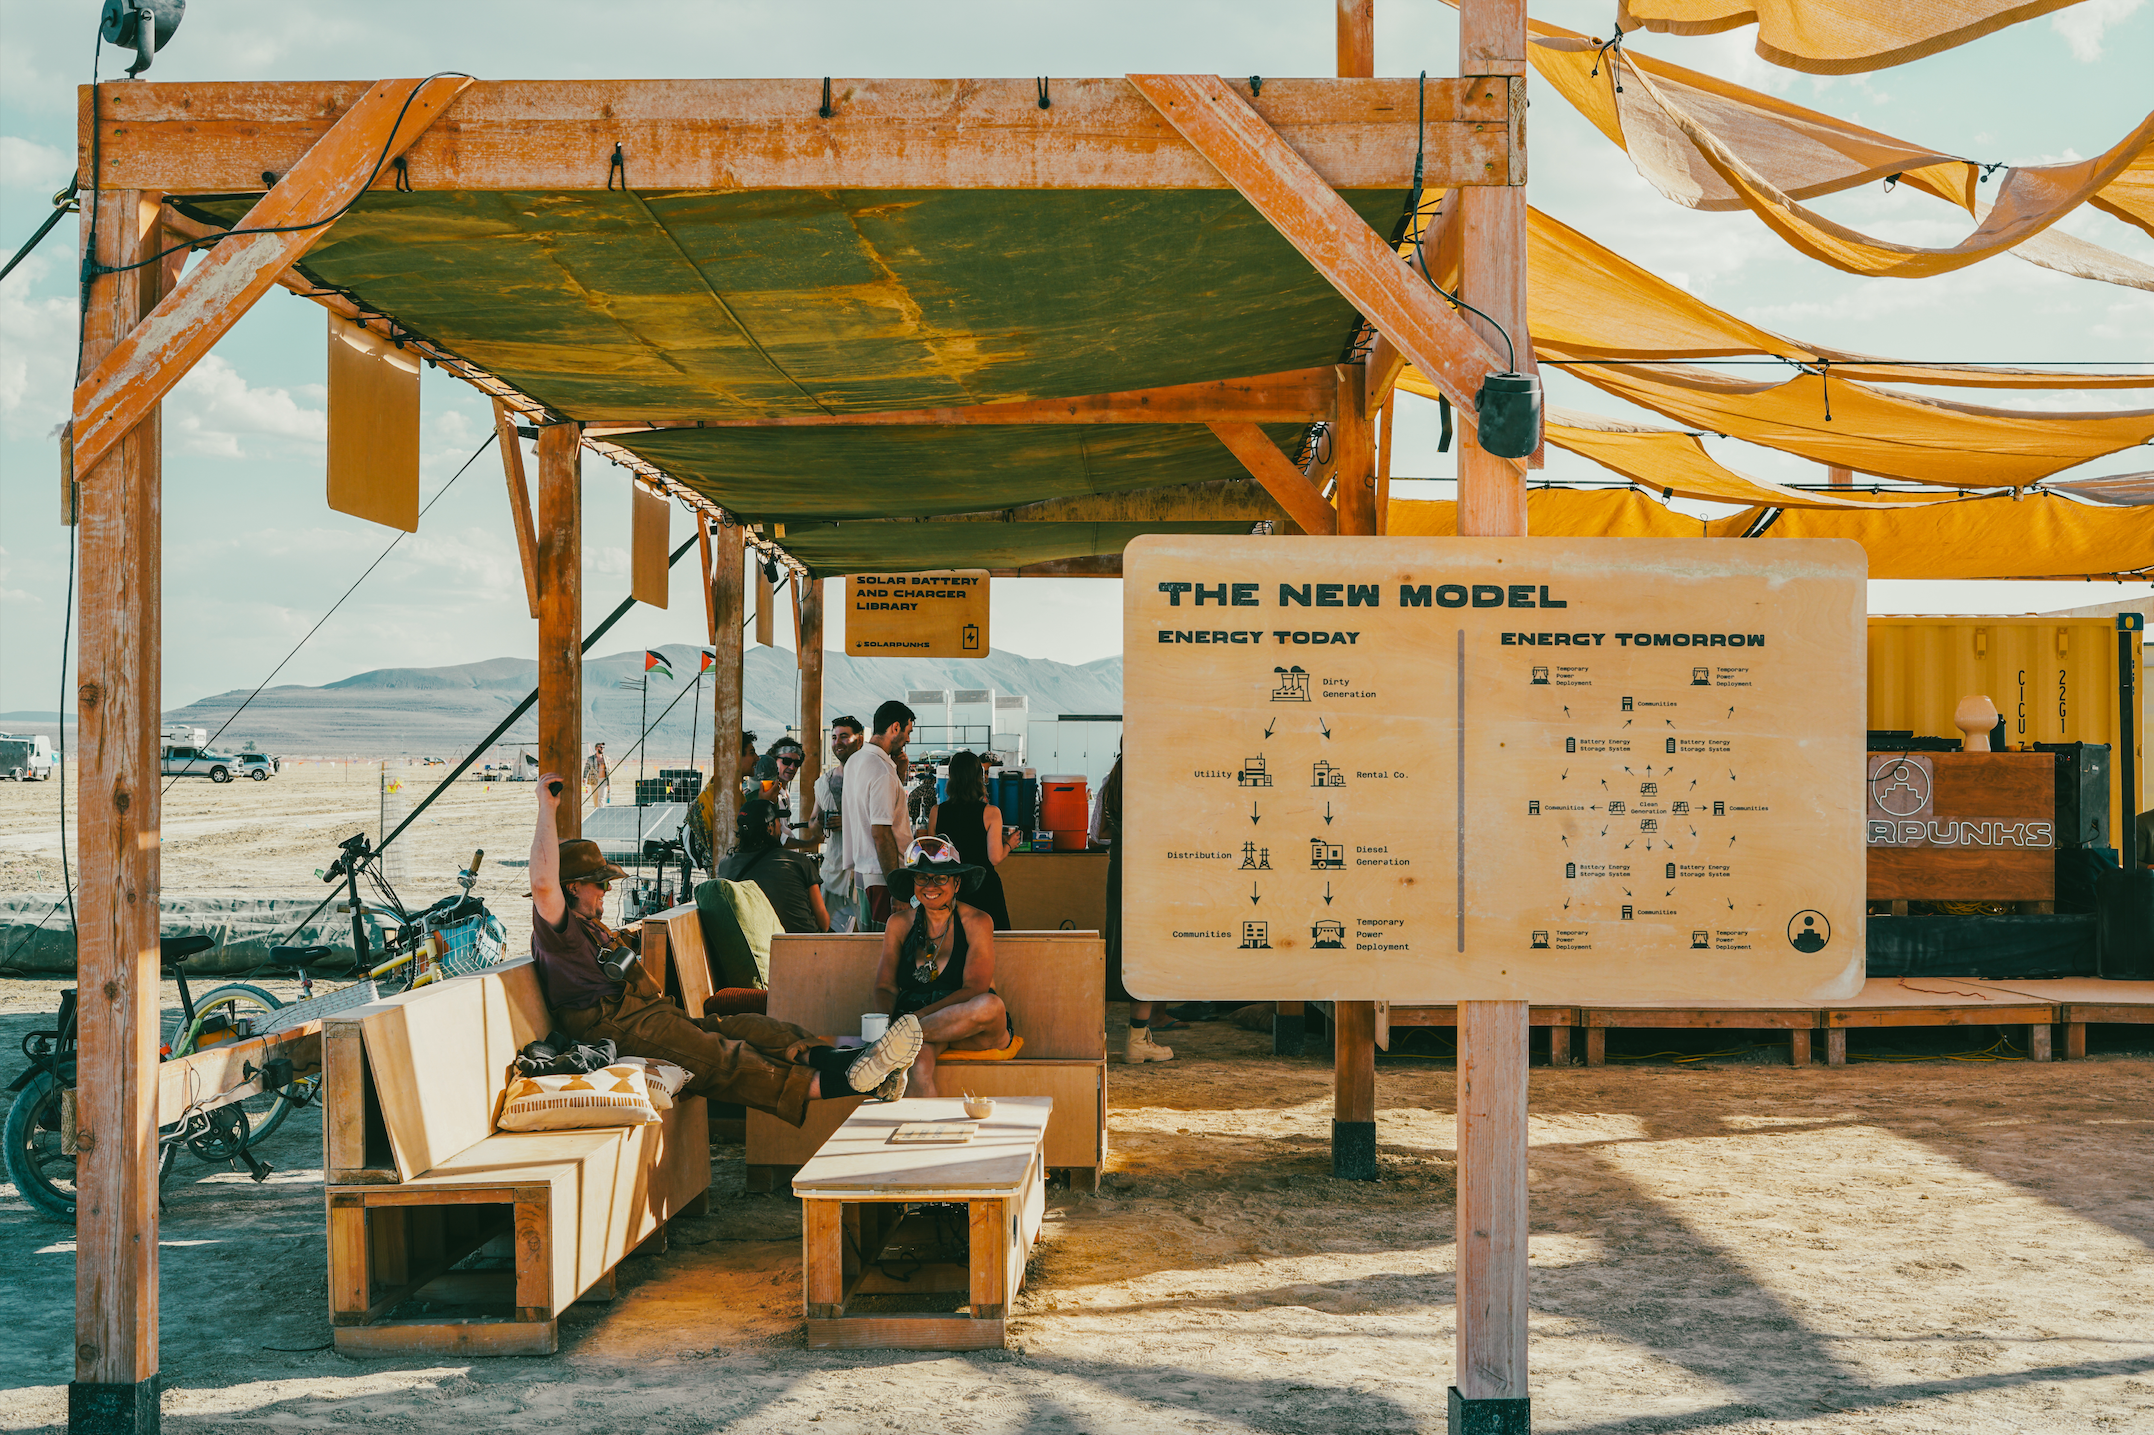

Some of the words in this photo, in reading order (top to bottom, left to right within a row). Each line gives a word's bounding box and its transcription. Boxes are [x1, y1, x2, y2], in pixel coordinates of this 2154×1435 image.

[856, 576, 907, 585] SOLAR
[911, 576, 980, 586] BATTERY
[856, 589, 889, 598] AND
[893, 589, 967, 599] CHARGER
[1159, 582, 1259, 606] THE
[1280, 584, 1379, 607] NEW
[1400, 585, 1567, 608] MODEL
[856, 602, 919, 611] LIBRARY
[1159, 631, 1263, 643] ENERGY
[1273, 631, 1360, 644] TODAY
[1501, 633, 1605, 645] ENERGY
[1615, 633, 1764, 646] TOMORROW
[1322, 677, 1350, 687] Dirty
[1322, 690, 1377, 698] Generation
[1579, 738, 1606, 746] Battery
[1580, 745, 1606, 753] Storage
[1194, 770, 1232, 780] Utility
[1356, 770, 1389, 779] Rental
[1393, 771, 1409, 779] Co.
[1356, 845, 1388, 854] Diesel
[1167, 851, 1232, 859] Distribution
[1356, 857, 1410, 866] Generation
[1356, 918, 1405, 927] Temporary
[1172, 930, 1232, 938] Communities
[1356, 930, 1383, 938] Power
[1356, 942, 1410, 952] Deployment
